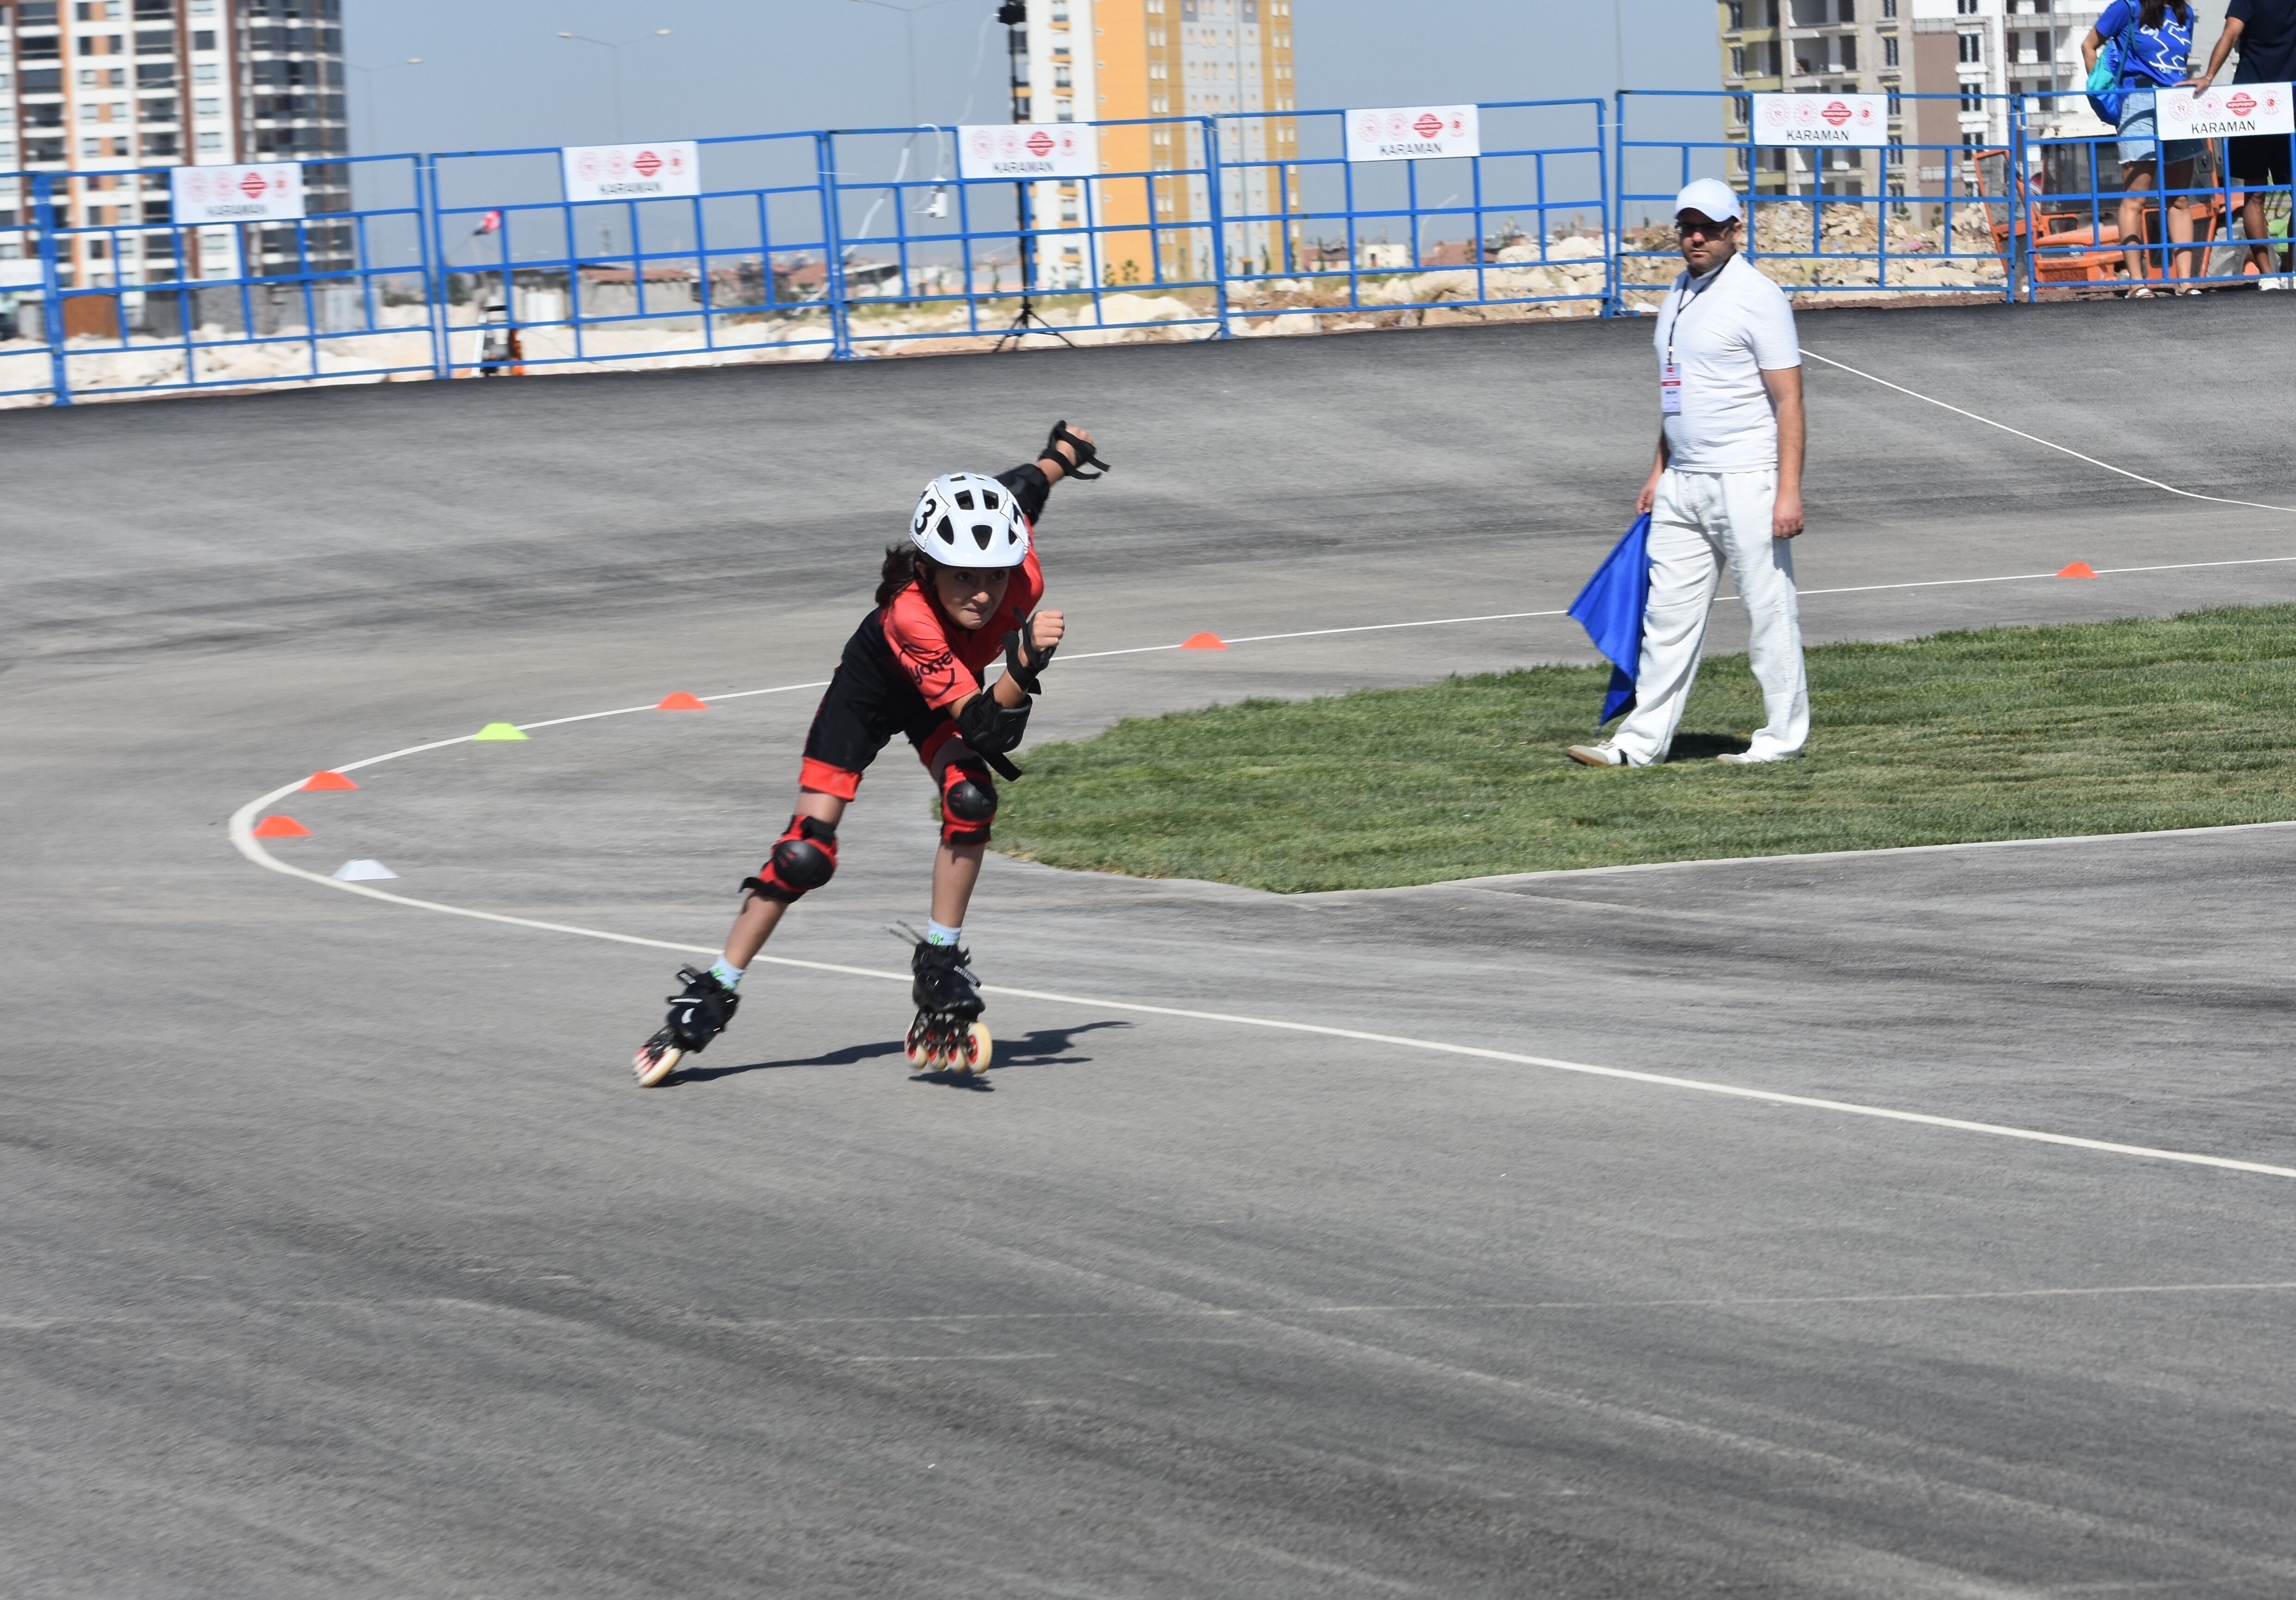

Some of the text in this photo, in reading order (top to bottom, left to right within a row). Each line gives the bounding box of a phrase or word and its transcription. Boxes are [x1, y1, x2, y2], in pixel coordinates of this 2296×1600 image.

[2191, 120, 2256, 134] KARAMAN
[1787, 129, 1849, 142] KARAMAN
[1379, 142, 1443, 156] KARAMAN
[993, 161, 1055, 174] KARAMAN
[915, 498, 937, 535] 3
